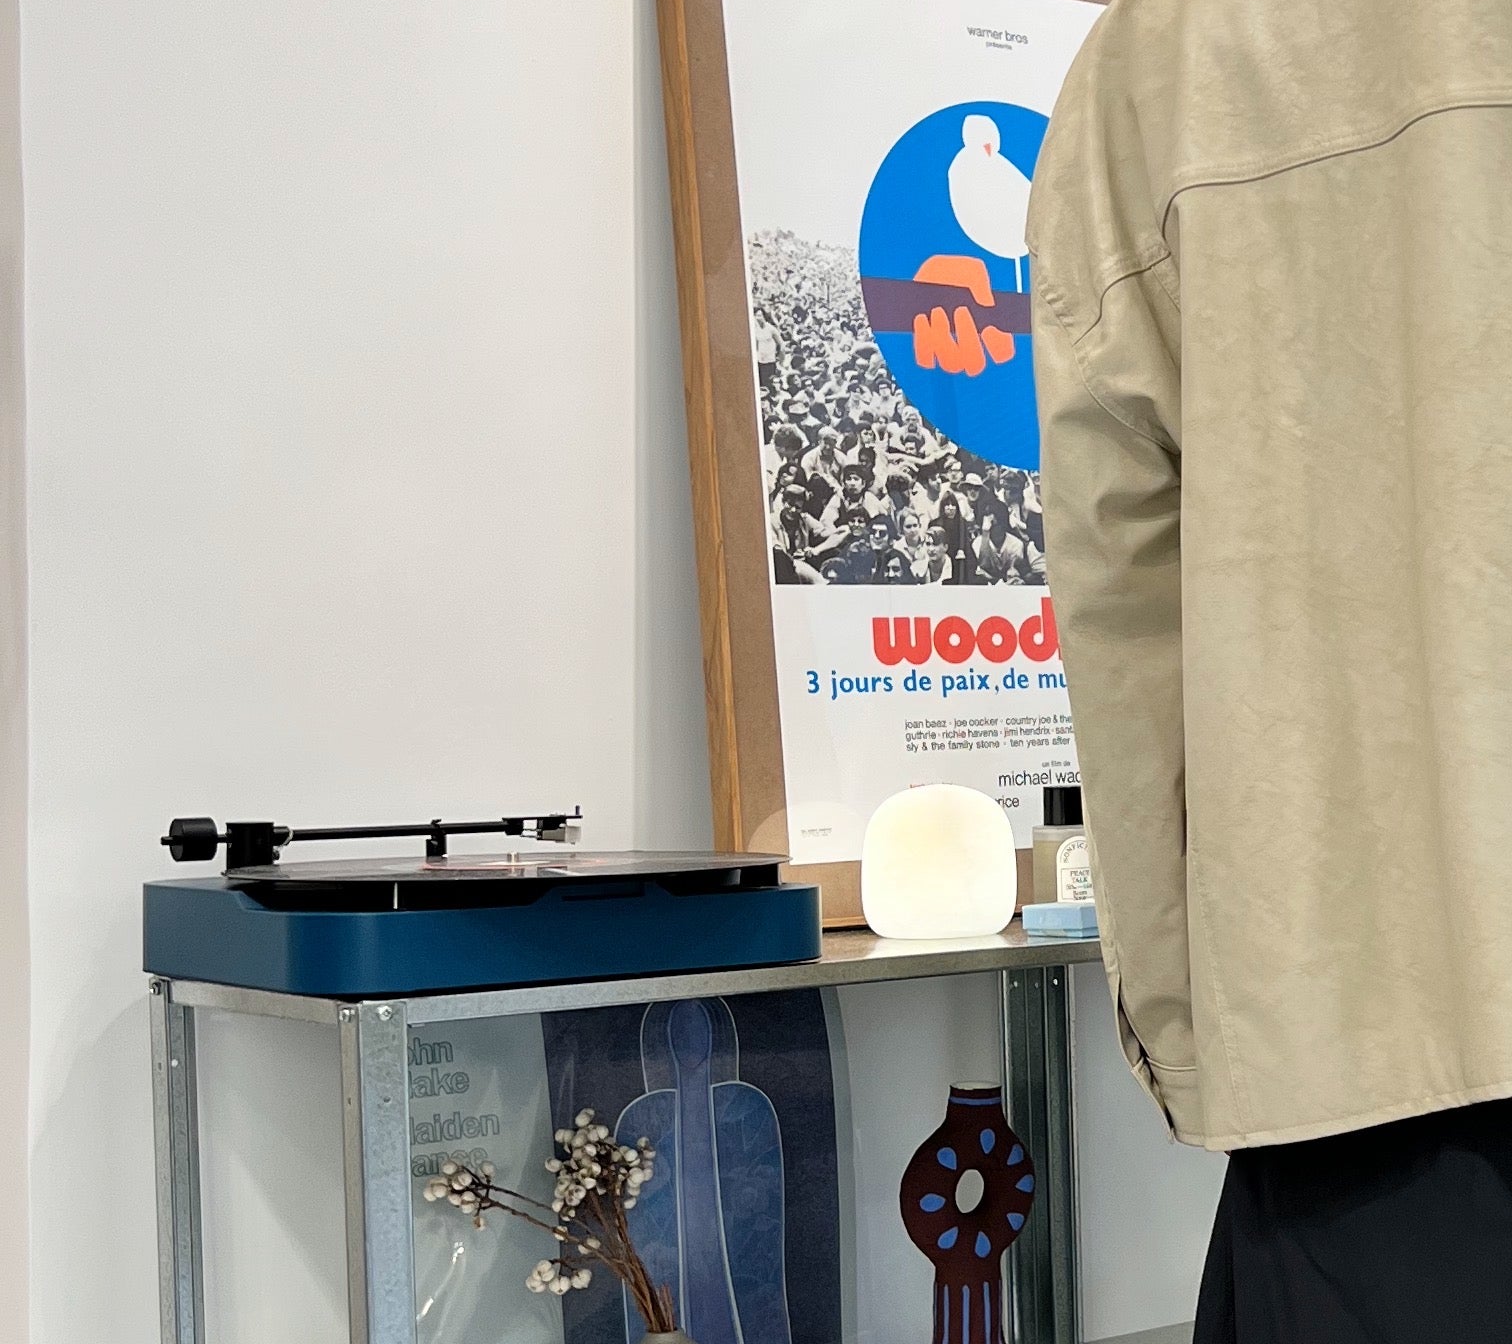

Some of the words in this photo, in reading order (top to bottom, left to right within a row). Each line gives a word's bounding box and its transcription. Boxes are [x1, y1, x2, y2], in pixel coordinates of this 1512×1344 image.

[967, 26, 1002, 40] warner
[1005, 30, 1028, 44] bros
[872, 597, 1060, 665] wood
[806, 670, 820, 694] 3
[831, 670, 893, 700] jours
[903, 669, 932, 692] de
[1002, 667, 1029, 690] de
[905, 719, 924, 730] joan
[1055, 726, 1074, 735] sant
[998, 769, 1051, 786] michael
